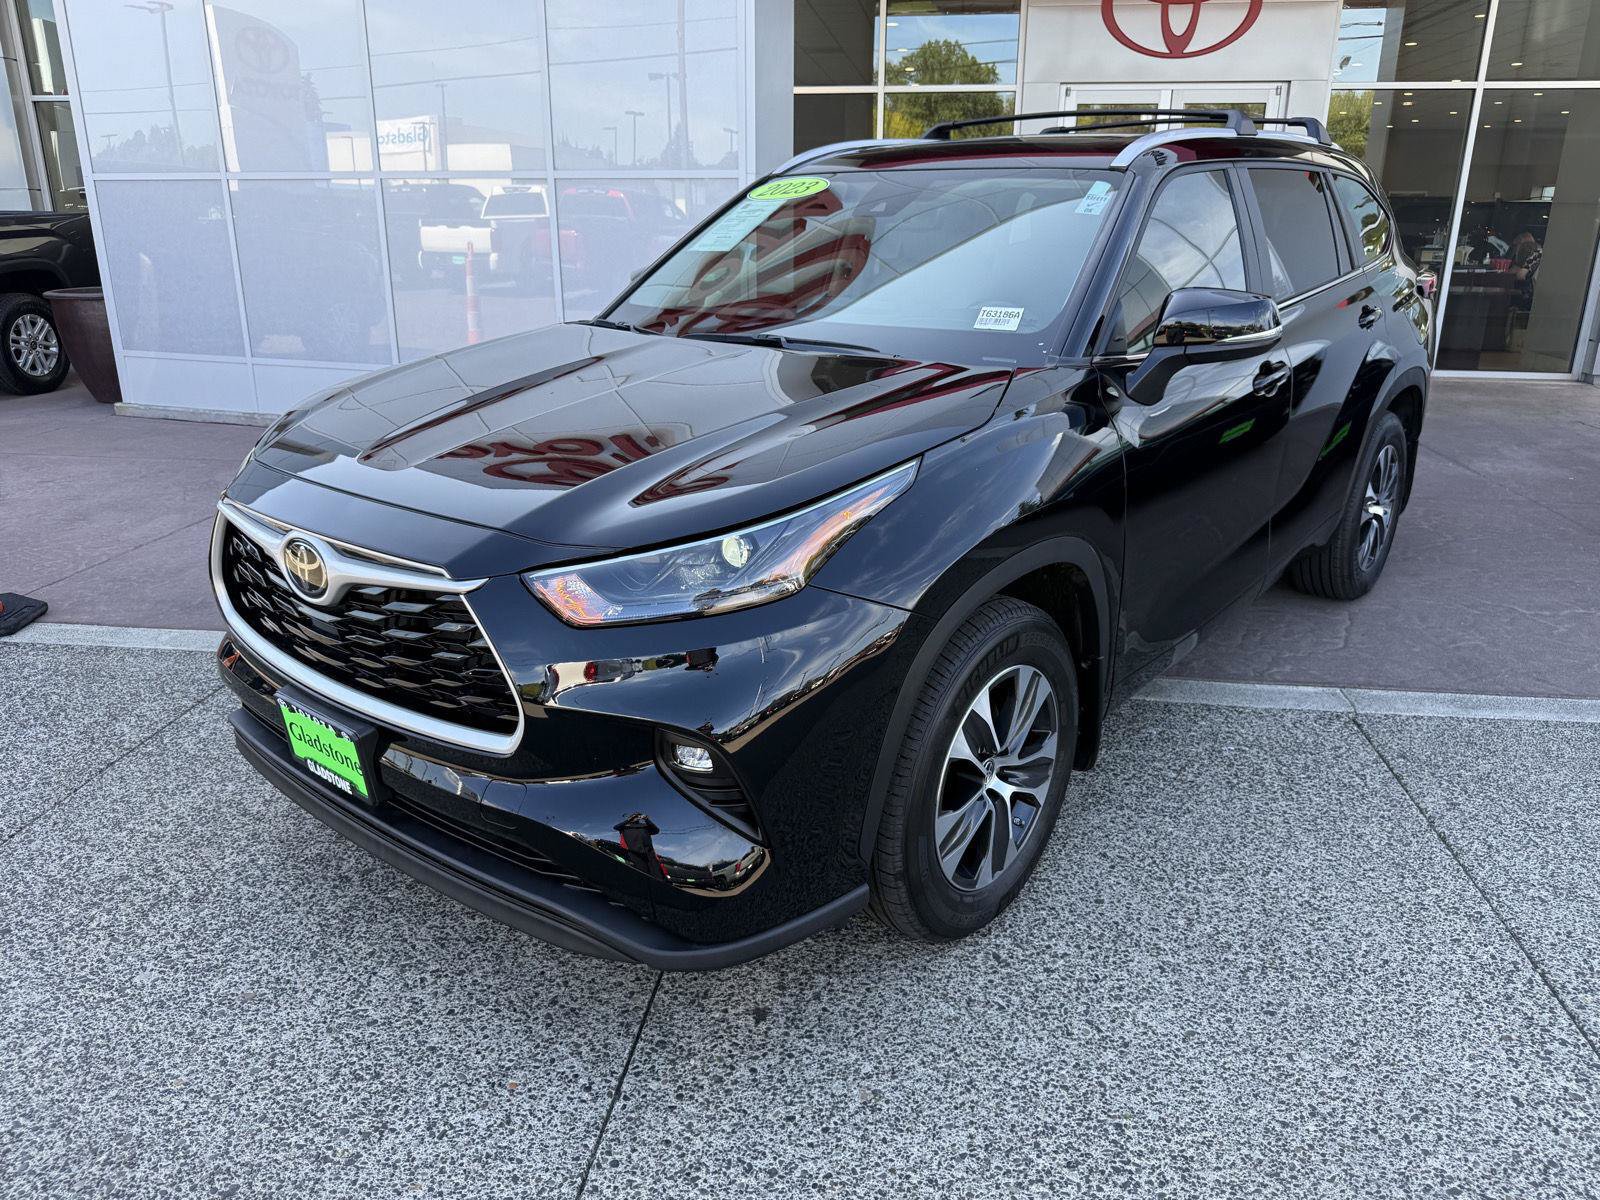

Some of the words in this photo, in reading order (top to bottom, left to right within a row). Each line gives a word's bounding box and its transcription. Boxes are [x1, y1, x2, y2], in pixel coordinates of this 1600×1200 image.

[755, 181, 820, 197] 2023
[288, 721, 364, 777] Gladstone
[306, 758, 353, 795] GLADSTONE
